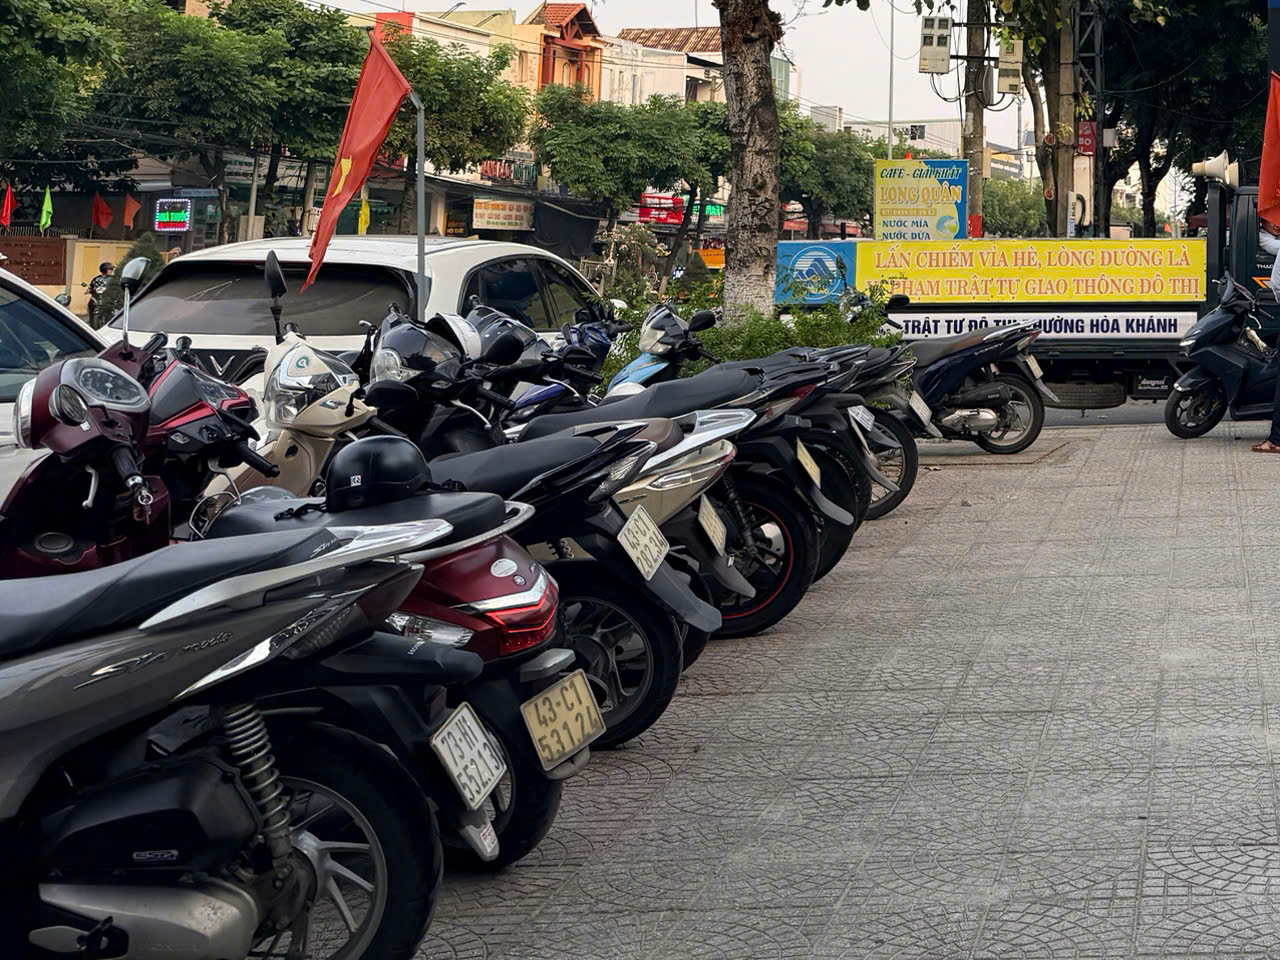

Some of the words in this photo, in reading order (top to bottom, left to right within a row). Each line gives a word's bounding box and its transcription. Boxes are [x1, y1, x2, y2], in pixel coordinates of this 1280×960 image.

[911, 218, 929, 228] MÍA
[875, 244, 912, 269] LẤN
[915, 244, 974, 269] CHIẾM
[1013, 246, 1042, 270] HÈ,
[1046, 246, 1095, 267] LÒNG
[1167, 245, 1191, 266] LÀ
[945, 275, 993, 300] TRẬT
[1024, 278, 1068, 295] GIAO
[1072, 274, 1135, 295] THÔNG
[1139, 274, 1164, 295] ĐÔ
[1169, 278, 1200, 299] THỊ
[903, 316, 941, 338] TRẬT
[1029, 315, 1085, 334] HƯỜNG
[1090, 315, 1121, 334] HÒA
[1125, 315, 1178, 334] KHÁNH
